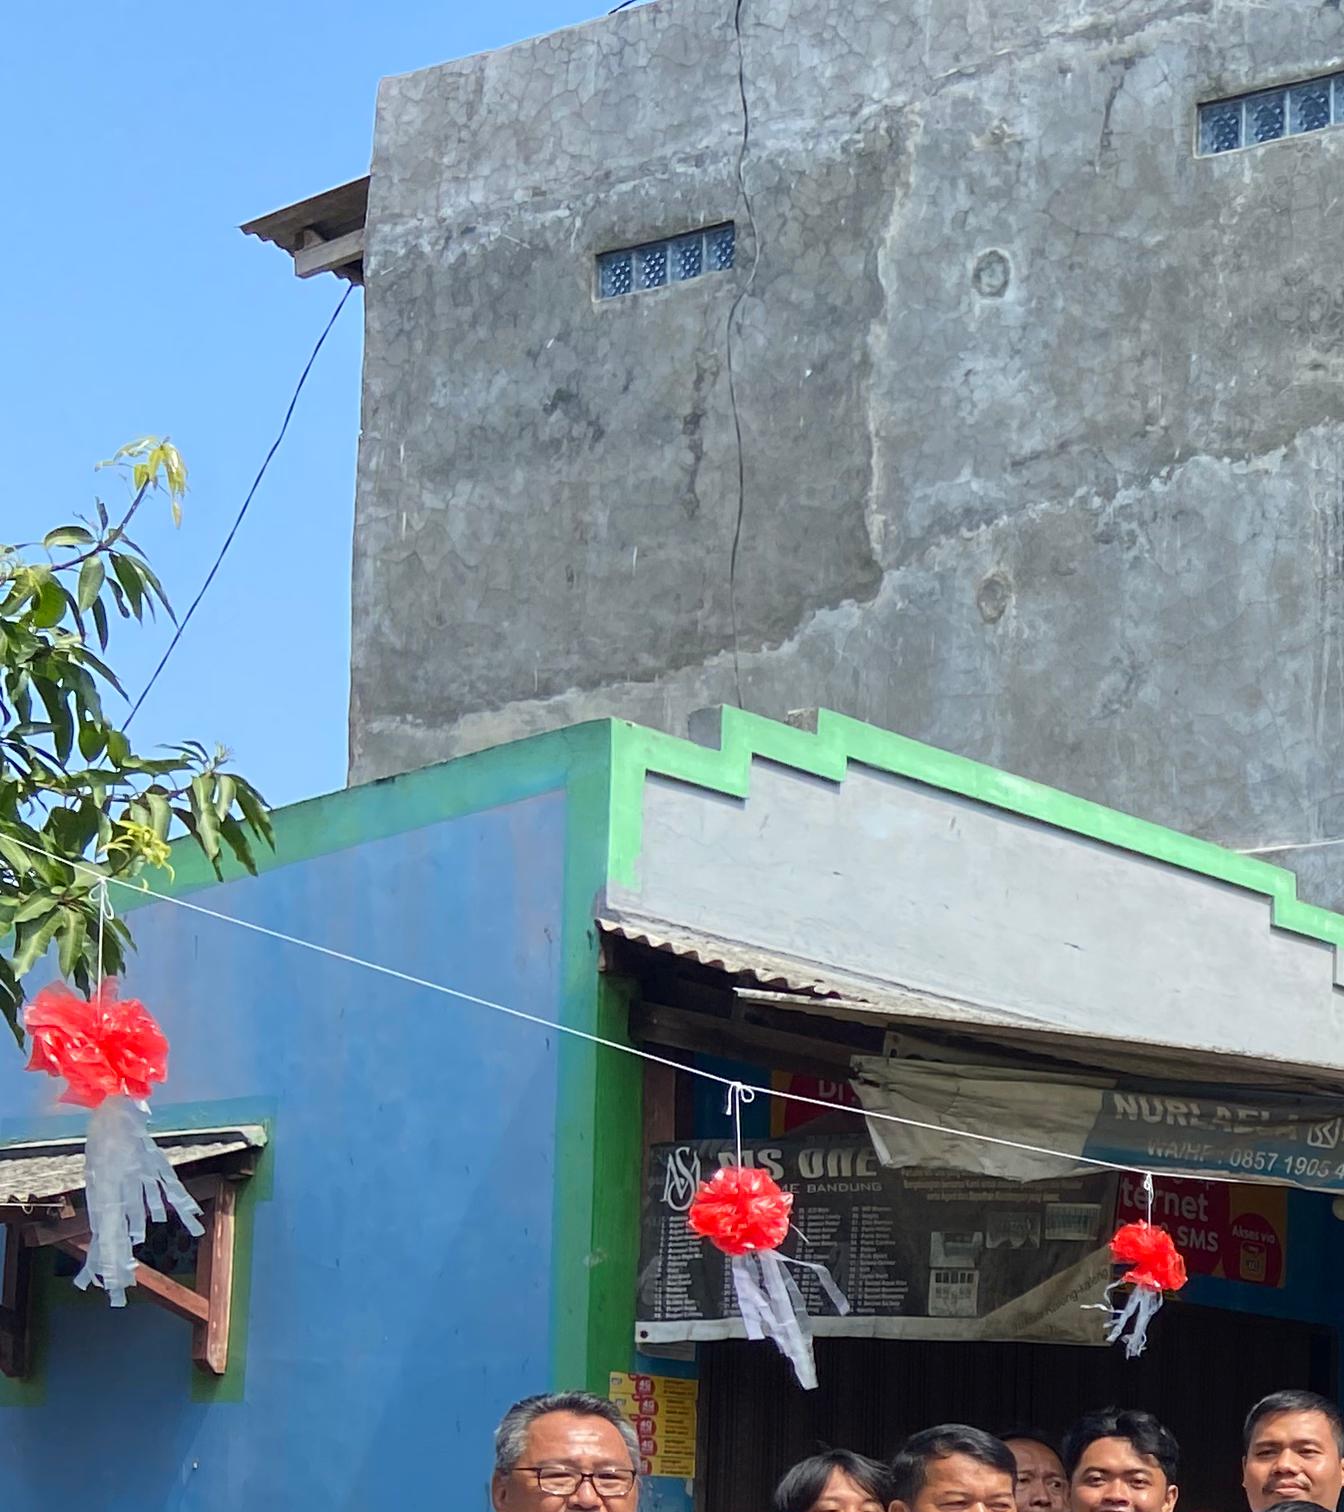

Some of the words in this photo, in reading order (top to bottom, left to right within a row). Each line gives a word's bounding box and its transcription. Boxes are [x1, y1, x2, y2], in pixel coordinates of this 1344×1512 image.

[1229, 1148, 1278, 1170] 0857
[1284, 1154, 1333, 1177] 1905
[807, 1182, 882, 1194] BANDUNG
[1177, 1226, 1219, 1253] SMS
